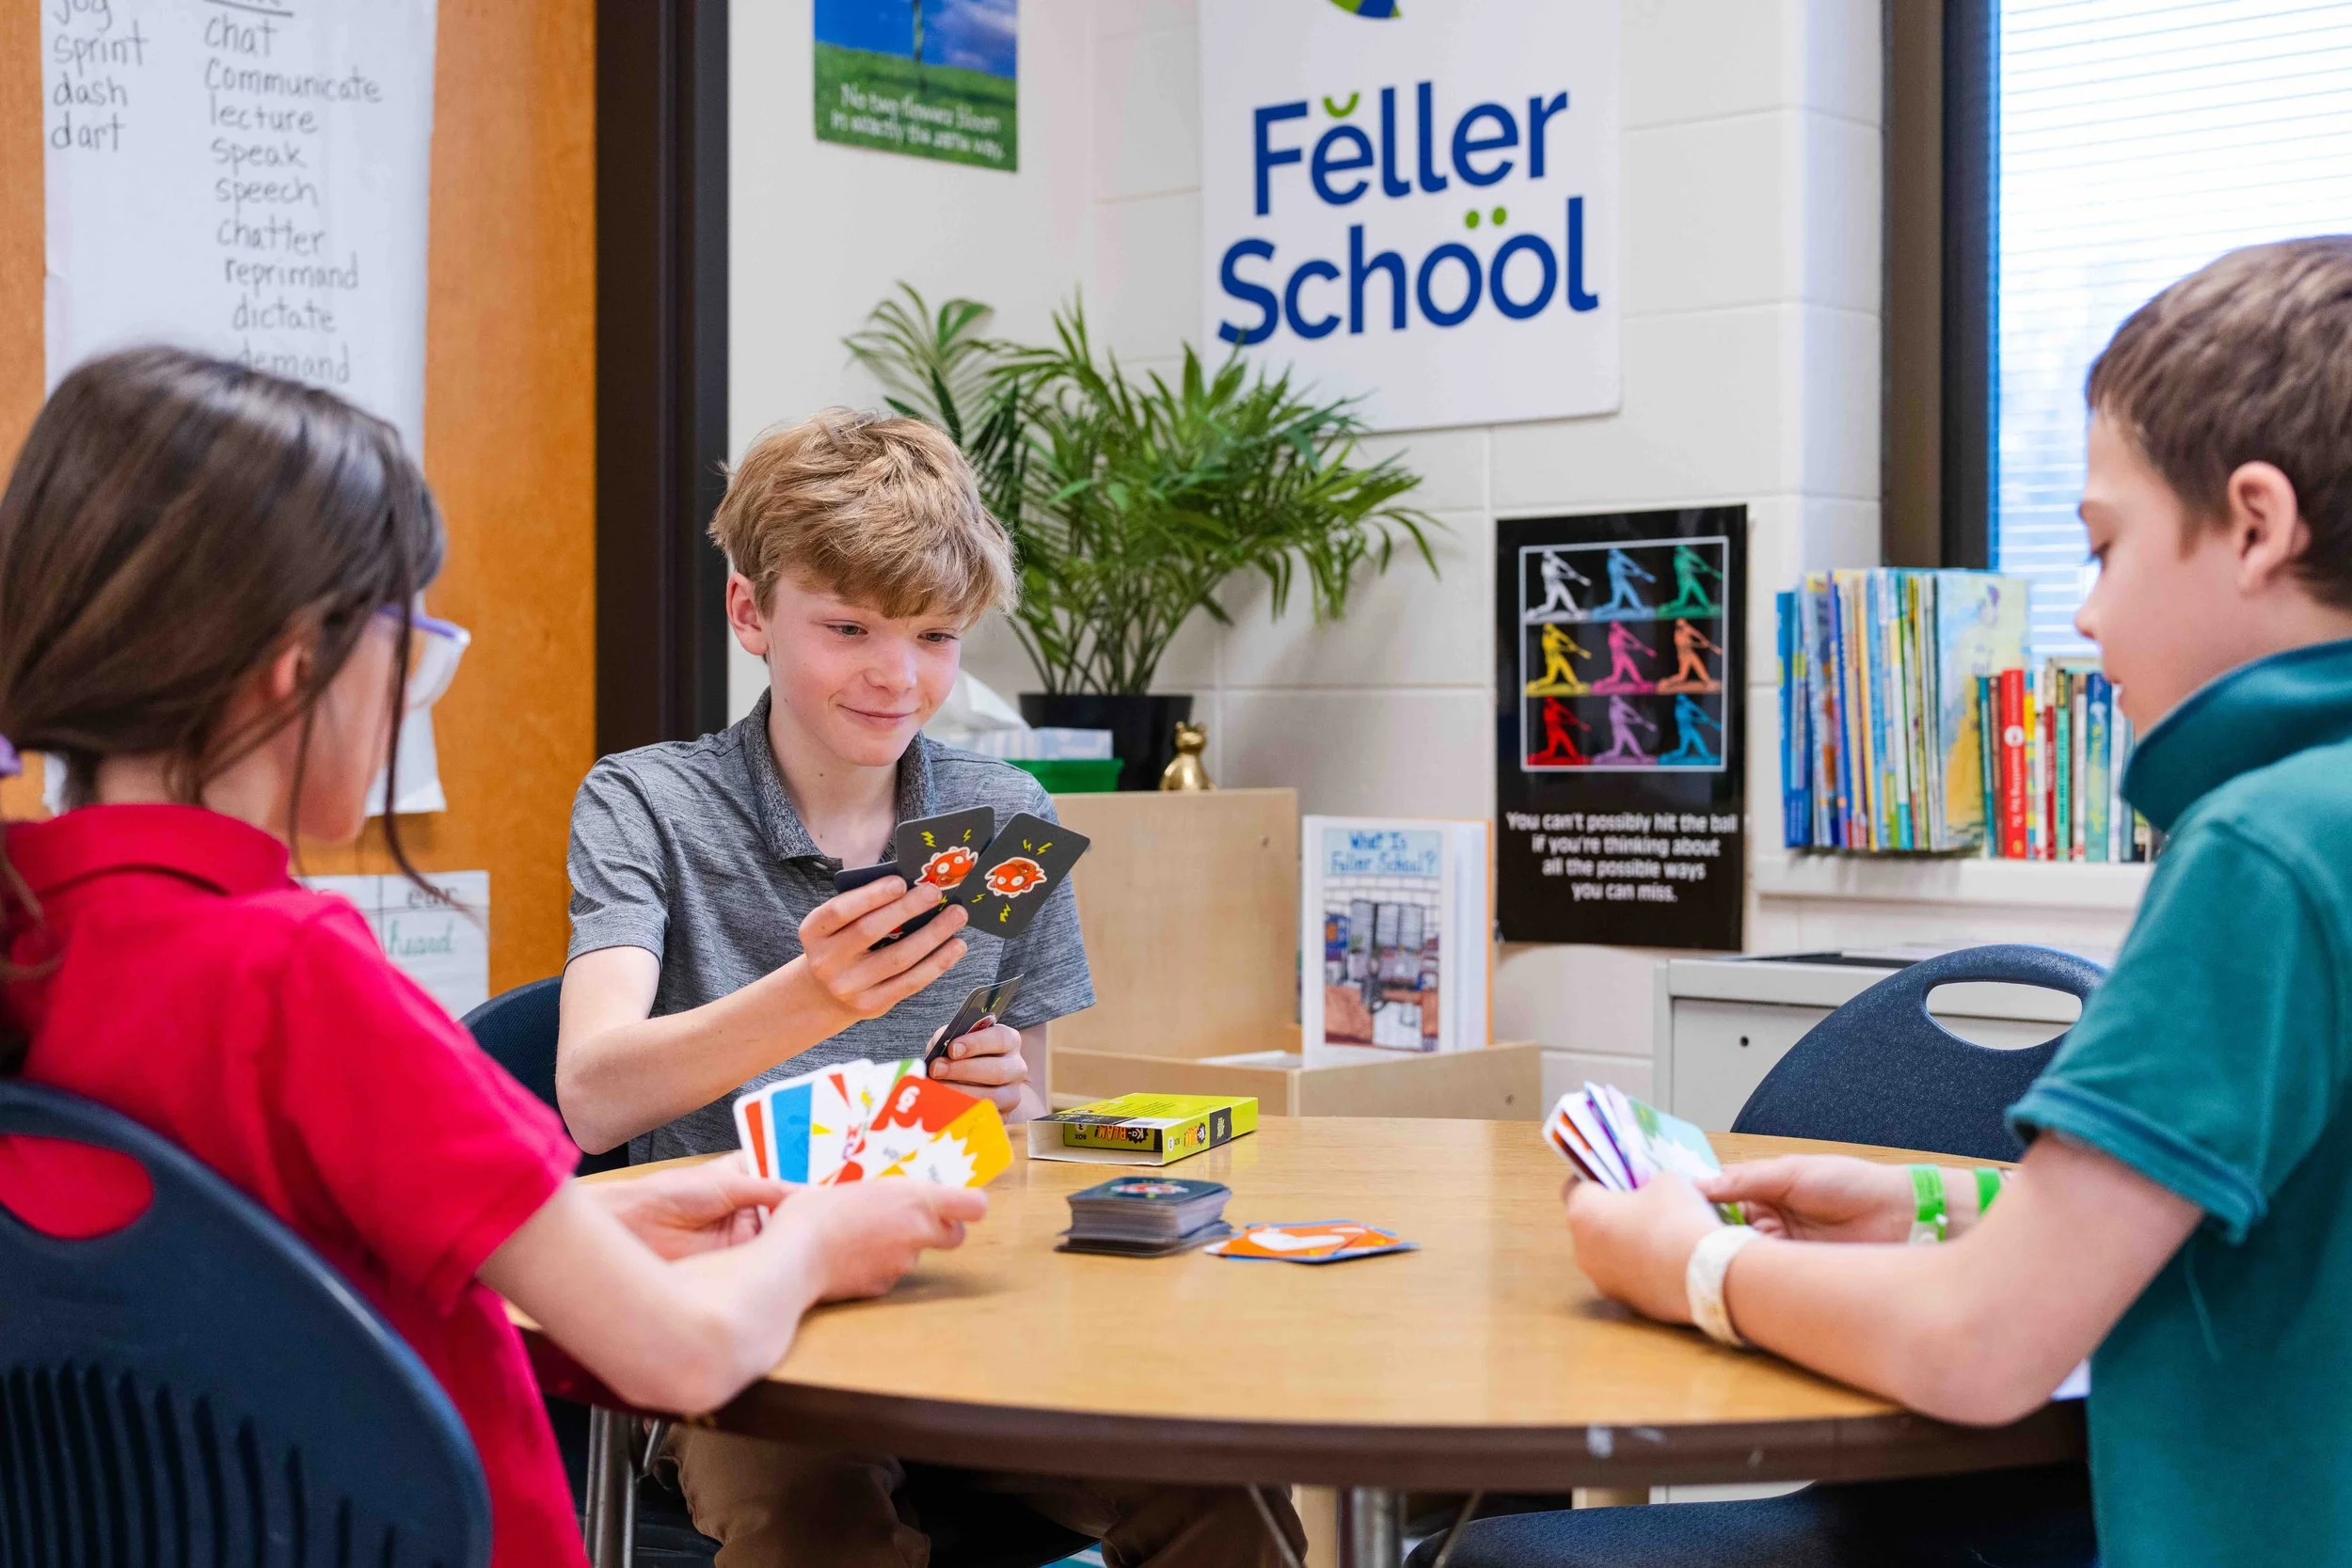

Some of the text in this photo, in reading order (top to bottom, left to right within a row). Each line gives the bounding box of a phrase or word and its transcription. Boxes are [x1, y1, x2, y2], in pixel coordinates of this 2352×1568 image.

[53, 19, 151, 77] sprint
[53, 71, 129, 106] dash
[51, 110, 126, 150] dart
[210, 93, 319, 134] lecture
[211, 136, 309, 178] speak
[215, 175, 319, 214] speech
[225, 250, 359, 299] reprimand
[231, 293, 338, 333] dictate
[1506, 812, 1739, 834] You can't possibly hit the ball
[1532, 833, 1721, 858] if you're thinking about
[1541, 858, 1707, 882] all the possible ways
[1571, 882, 1678, 903] you can miss.
